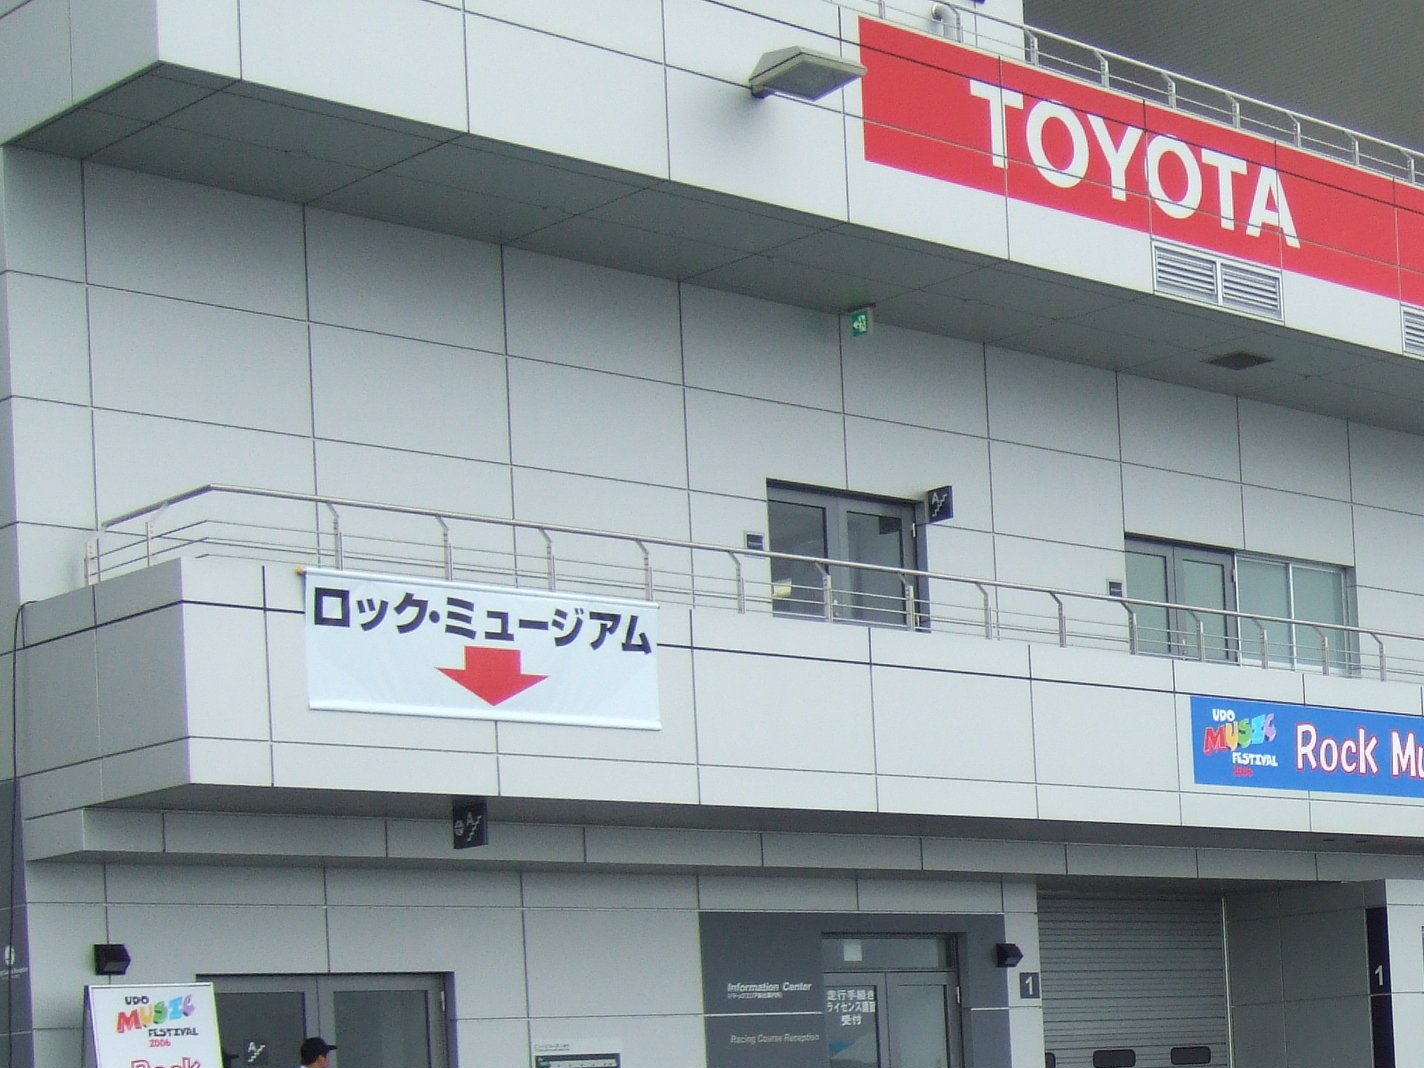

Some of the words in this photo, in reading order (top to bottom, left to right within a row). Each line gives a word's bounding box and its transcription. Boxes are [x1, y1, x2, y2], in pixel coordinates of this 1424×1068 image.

[969, 79, 1301, 249] TOYOTA
[313, 586, 653, 655] ロック・ミュージアム
[1211, 708, 1236, 722] UDO
[1203, 712, 1277, 755] MUSIC
[1295, 722, 1379, 776] Rock
[1231, 751, 1279, 768] FESTIVAL
[1024, 975, 1034, 996] 1
[1374, 965, 1385, 987] 1
[727, 982, 780, 993] Information
[782, 981, 813, 991] Center
[124, 995, 150, 1006] UDO
[116, 994, 196, 1034] MUSIC
[147, 1027, 199, 1038] FESTIVAL
[730, 1034, 757, 1045] Racing
[757, 1033, 783, 1043] Course
[784, 1033, 820, 1043] Reception
[148, 1038, 172, 1048] 2006
